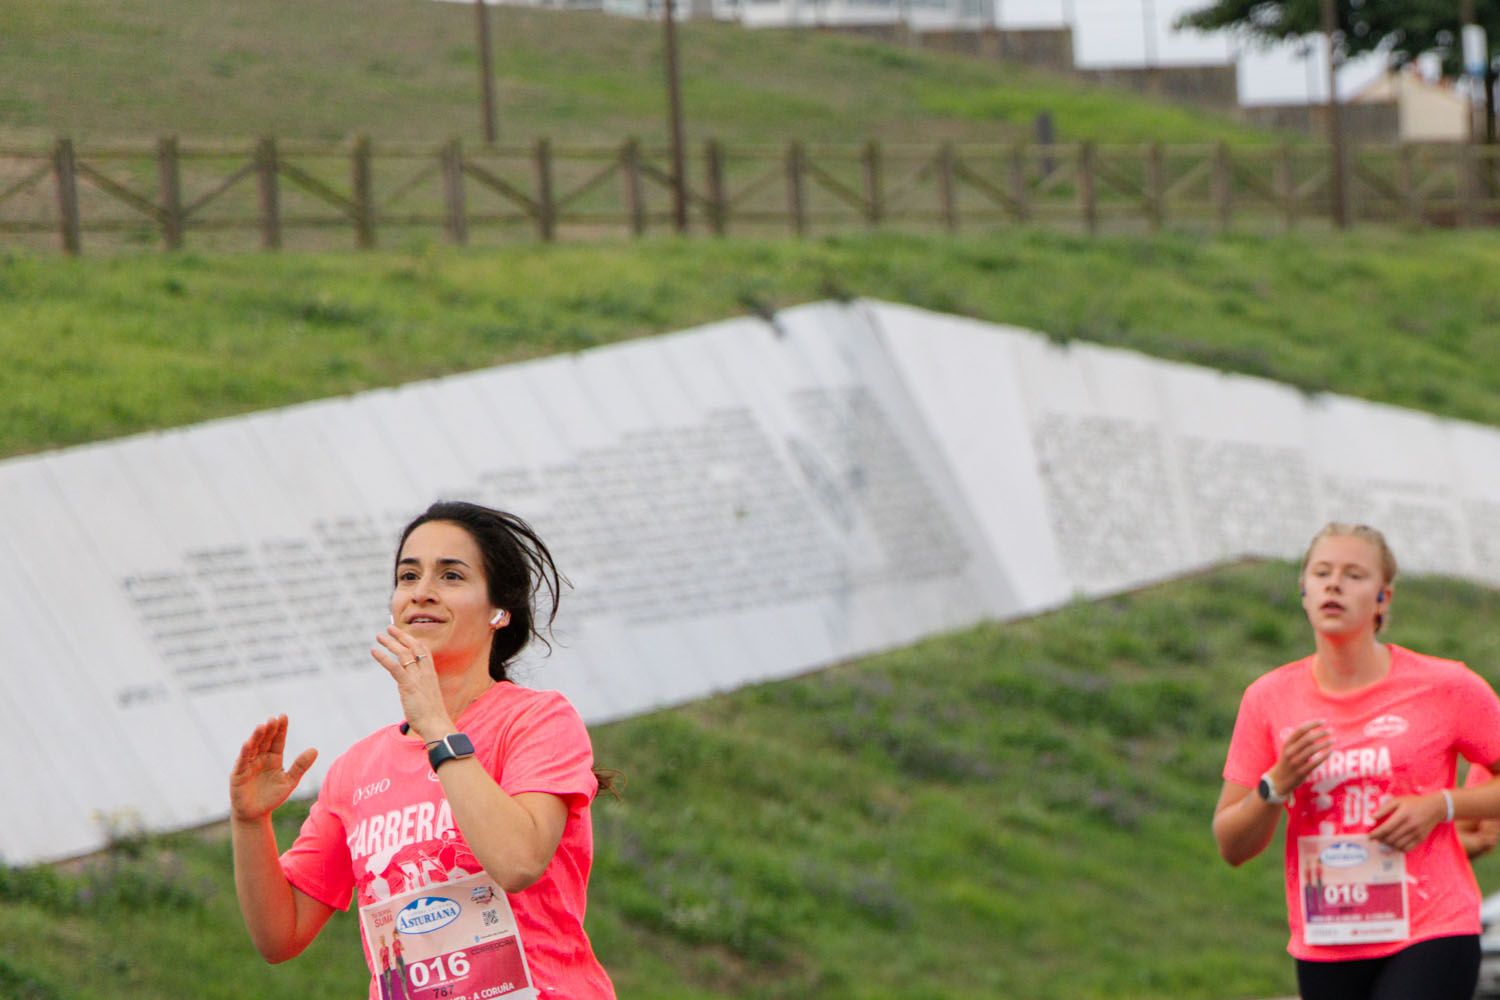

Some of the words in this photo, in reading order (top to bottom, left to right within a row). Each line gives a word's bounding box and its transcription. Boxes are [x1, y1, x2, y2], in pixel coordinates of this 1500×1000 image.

[352, 778, 391, 806] OYSHO
[1324, 884, 1369, 906] 016
[400, 907, 457, 929] ASTURIANA
[409, 951, 470, 987] 016
[473, 992, 480, 1000] A
[480, 982, 515, 999] CORUÑA
